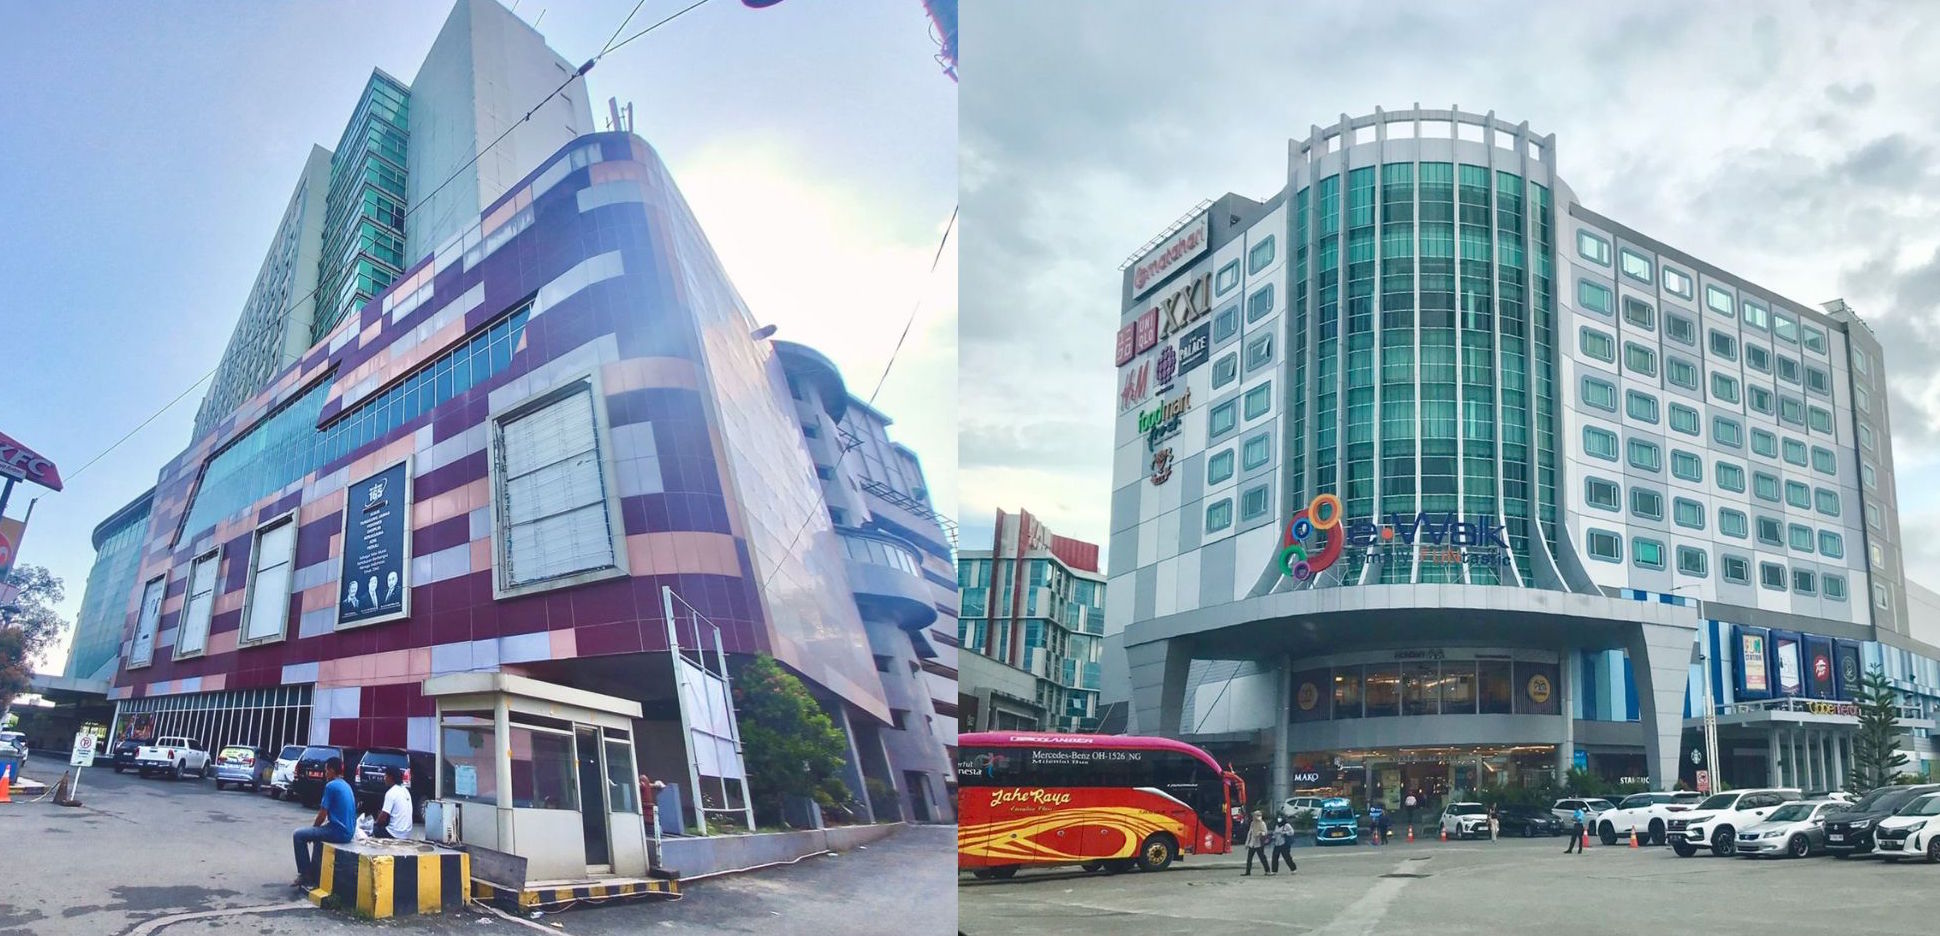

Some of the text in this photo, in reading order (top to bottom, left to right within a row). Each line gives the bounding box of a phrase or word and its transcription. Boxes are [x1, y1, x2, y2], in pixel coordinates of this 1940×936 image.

[1146, 219, 1206, 280] matahari
[1159, 271, 1212, 341] XXI
[1139, 312, 1155, 331] UNI
[1139, 328, 1155, 349] QLO
[1179, 336, 1207, 361] PALACE
[1121, 360, 1150, 411] H&M
[1138, 386, 1191, 434] foodmart
[0, 444, 51, 478] KFC
[1032, 751, 1142, 760] Mercedes-Benz OH-1526 NG
[1294, 773, 1319, 782] MAKO
[991, 788, 1071, 807] Jahe Raya
